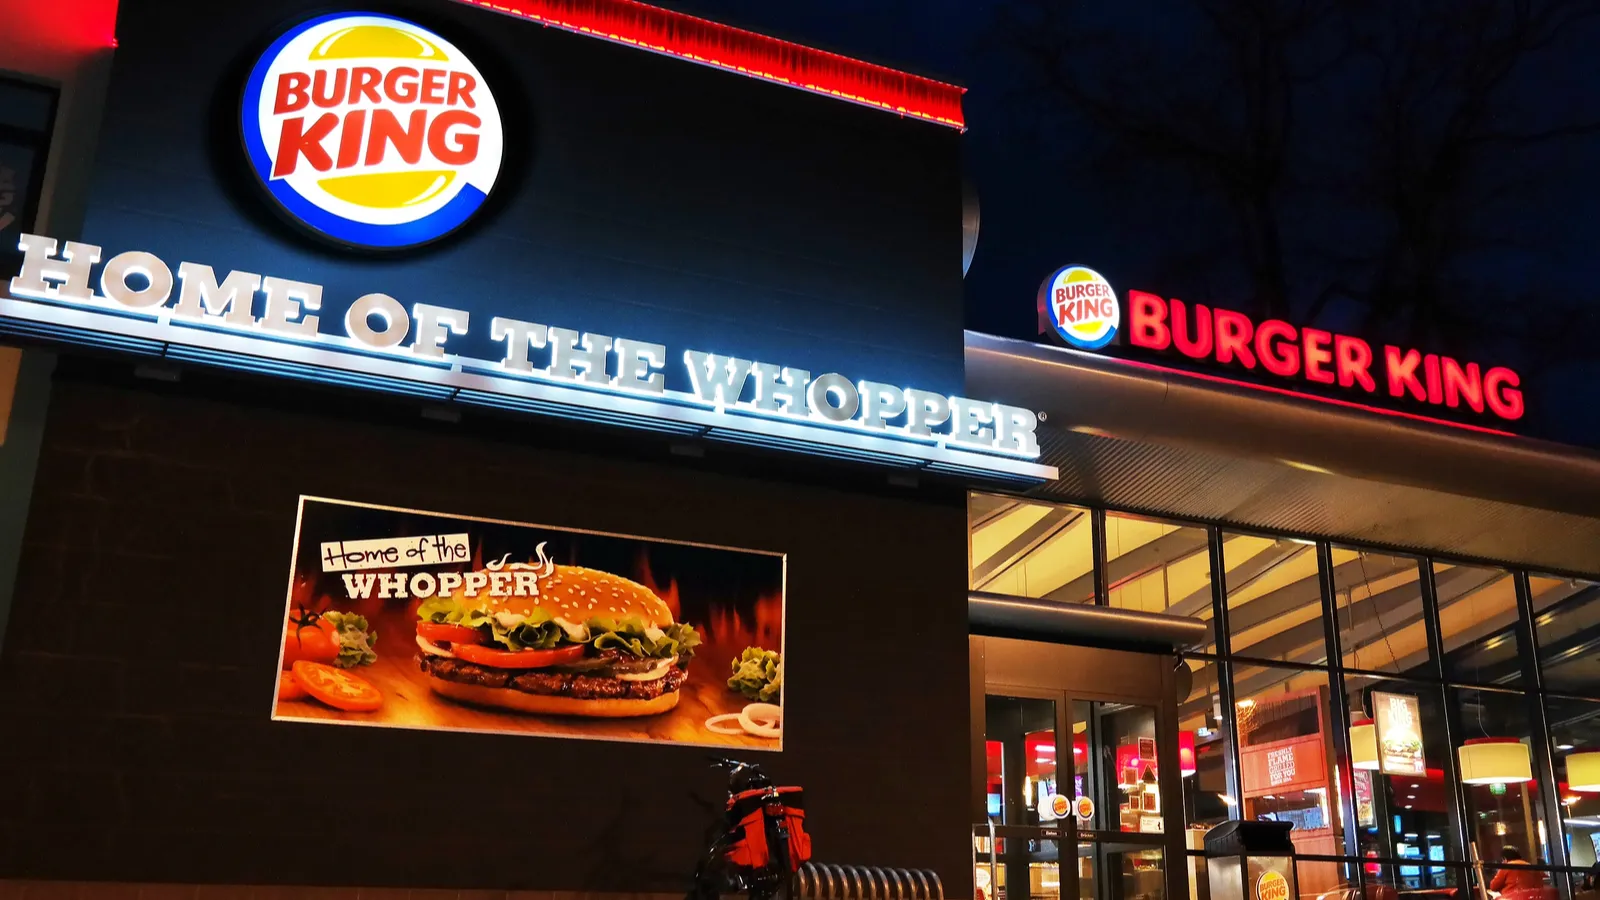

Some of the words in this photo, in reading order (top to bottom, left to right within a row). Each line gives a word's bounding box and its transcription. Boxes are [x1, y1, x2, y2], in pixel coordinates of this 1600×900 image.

[274, 66, 477, 114] BURGER
[274, 108, 482, 180] KING
[1056, 283, 1110, 303] BURGER
[1058, 298, 1113, 325] KING
[10, 233, 324, 338] HOME
[344, 293, 470, 361] OF
[490, 316, 666, 395] THE
[683, 350, 1041, 458] WHOPPER
[1128, 289, 1376, 393] BURGER
[1385, 344, 1525, 421] KING
[324, 541, 399, 568] Home
[406, 537, 429, 562] of
[432, 535, 467, 561] the
[342, 572, 540, 599] WHOPPER
[1268, 753, 1294, 766] FLAME
[1259, 878, 1285, 892] BURGER
[1261, 886, 1286, 900] KING
